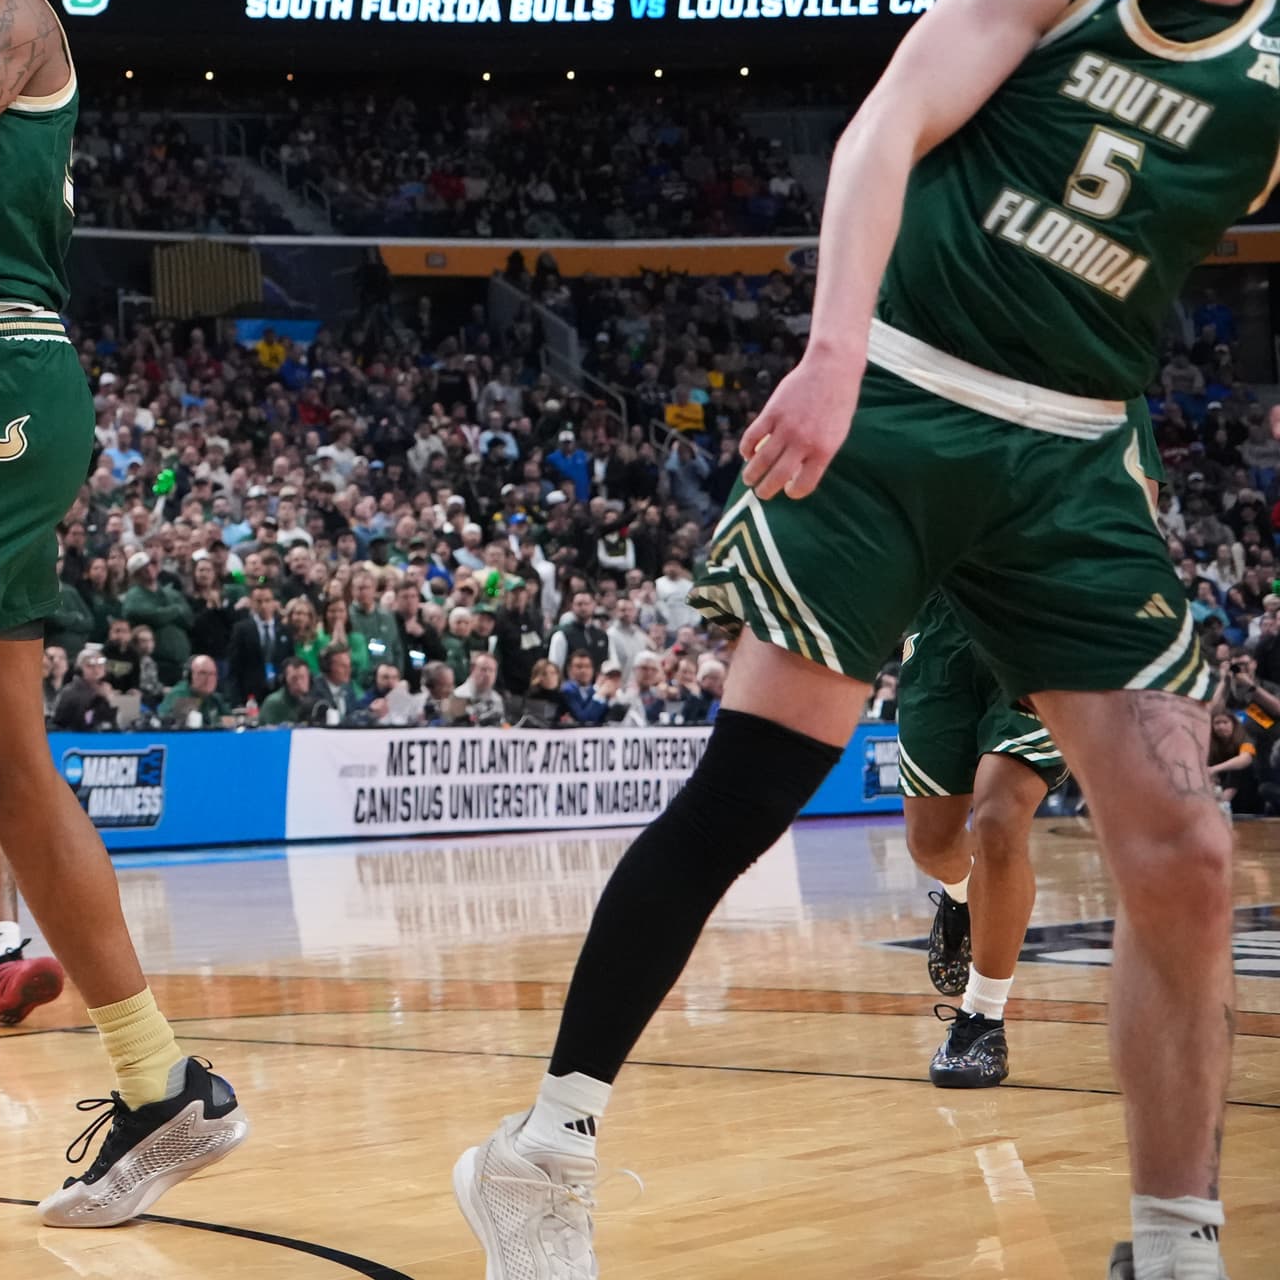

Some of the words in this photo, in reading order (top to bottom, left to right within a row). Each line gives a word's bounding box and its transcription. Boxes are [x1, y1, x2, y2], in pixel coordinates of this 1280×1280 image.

[1060, 51, 1214, 149] SOUTH
[1063, 125, 1146, 219] 5
[981, 188, 1151, 302] FLORIDA
[81, 755, 139, 787] MARCH
[386, 739, 451, 777] METRO
[458, 738, 538, 775] ATLANTIC
[539, 736, 616, 773] ATHLETIC
[88, 786, 163, 818] MADNESS
[354, 785, 443, 825] CANISIUS
[448, 783, 551, 821] UNIVERSITY
[556, 781, 590, 817] AND
[594, 778, 662, 814] NIAGARA
